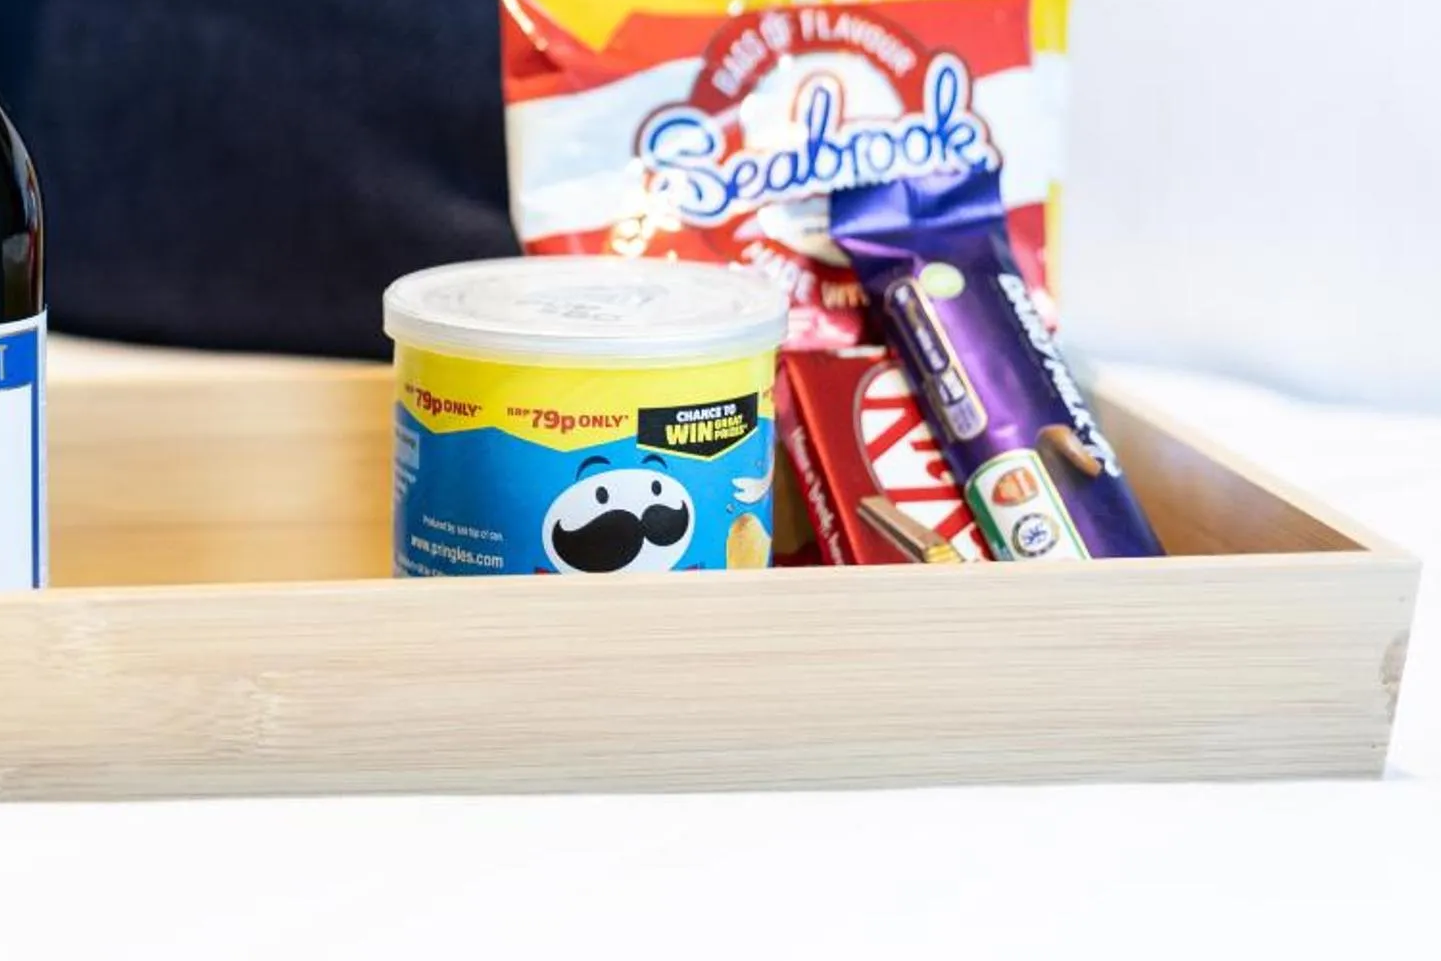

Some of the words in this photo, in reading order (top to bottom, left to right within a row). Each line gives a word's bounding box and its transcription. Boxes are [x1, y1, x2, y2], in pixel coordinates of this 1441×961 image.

[800, 7, 917, 77] FLAVOUR
[648, 65, 988, 216] Seabrook
[531, 409, 575, 434] 79p
[676, 405, 721, 422] CHANCE
[665, 421, 714, 445] WIN
[410, 534, 505, 569] www.pringles.com
